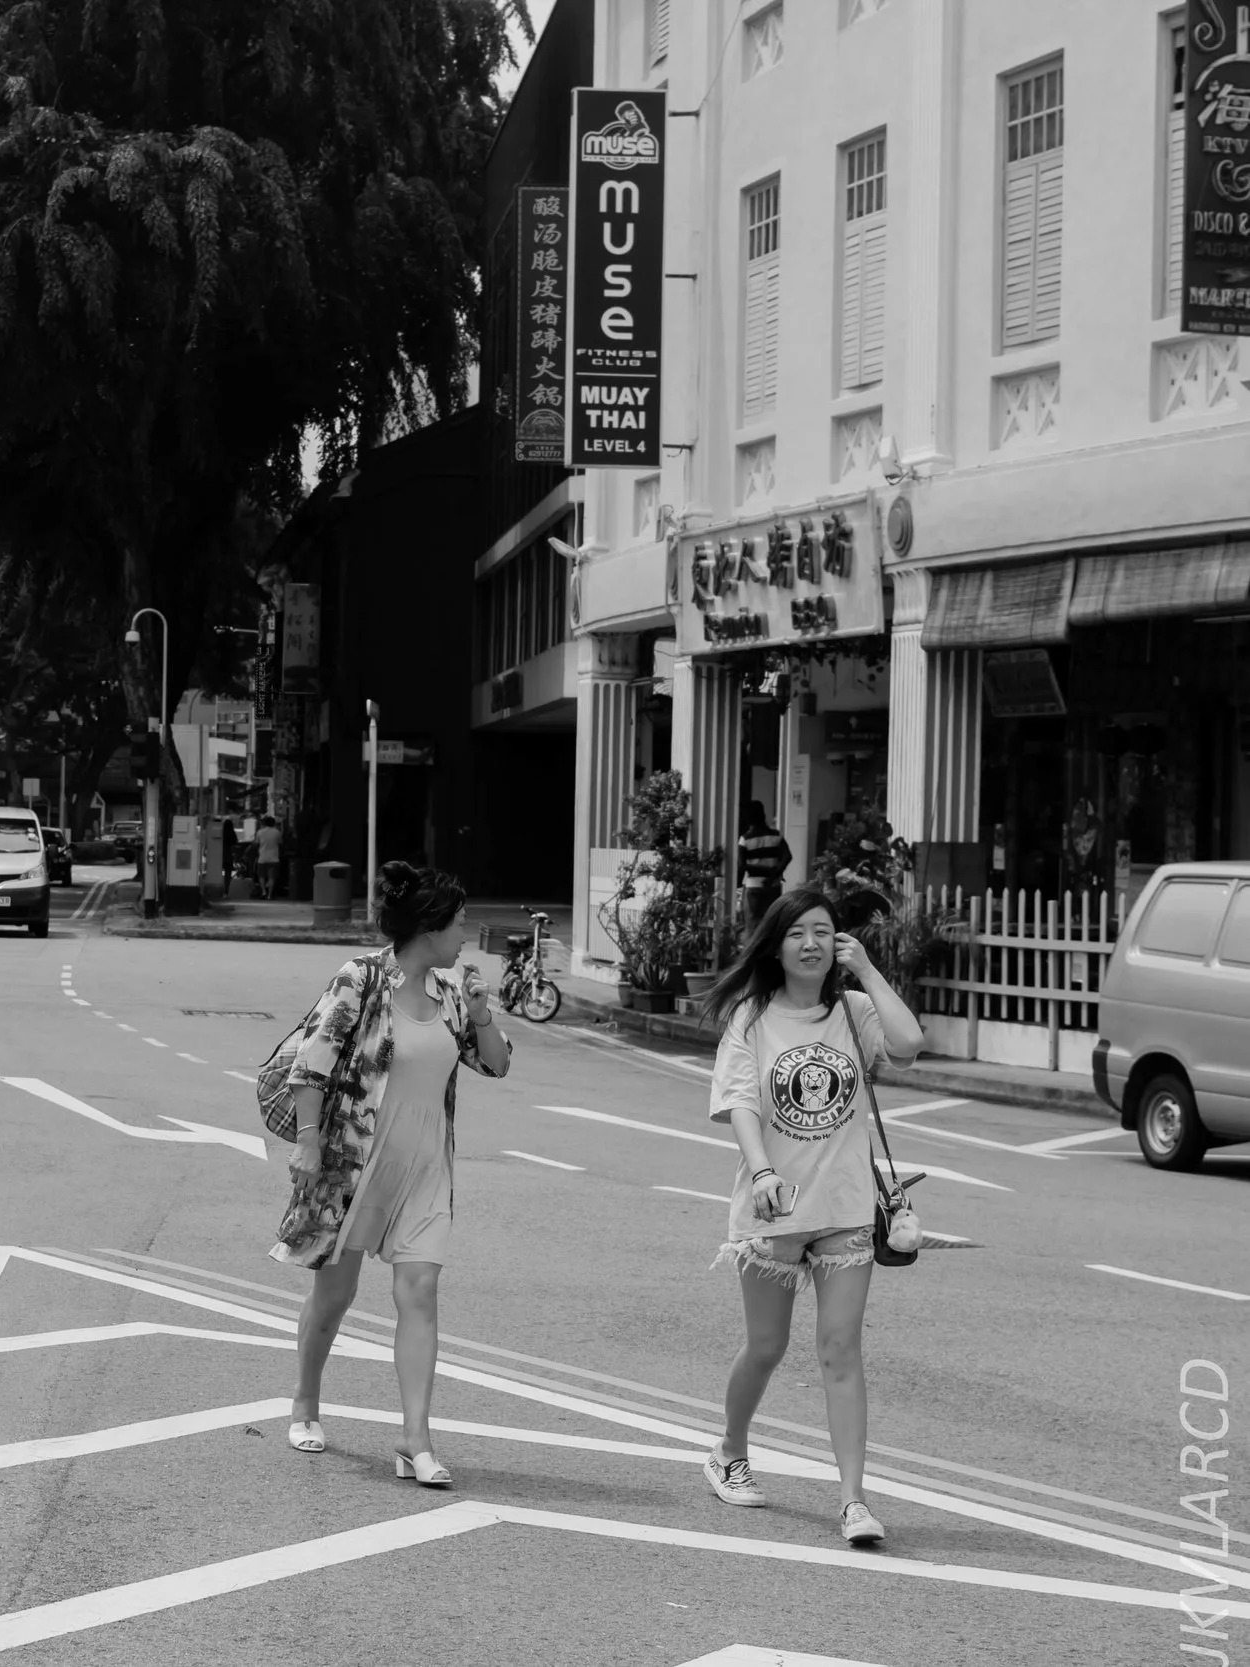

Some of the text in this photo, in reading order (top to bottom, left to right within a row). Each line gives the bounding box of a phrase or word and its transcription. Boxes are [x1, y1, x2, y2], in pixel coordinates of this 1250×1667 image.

[585, 135, 655, 156] muse
[1202, 135, 1249, 154] KTV
[1191, 209, 1234, 234] DISCO
[598, 179, 640, 341] muse
[575, 348, 658, 358] FITNESS
[591, 357, 642, 367] CLUB
[580, 385, 651, 406] MUAY
[585, 409, 647, 430] THAI
[583, 438, 646, 453] LEVEL 4
[775, 1046, 855, 1086] SINGAPORE
[780, 1096, 845, 1127] LION CITY
